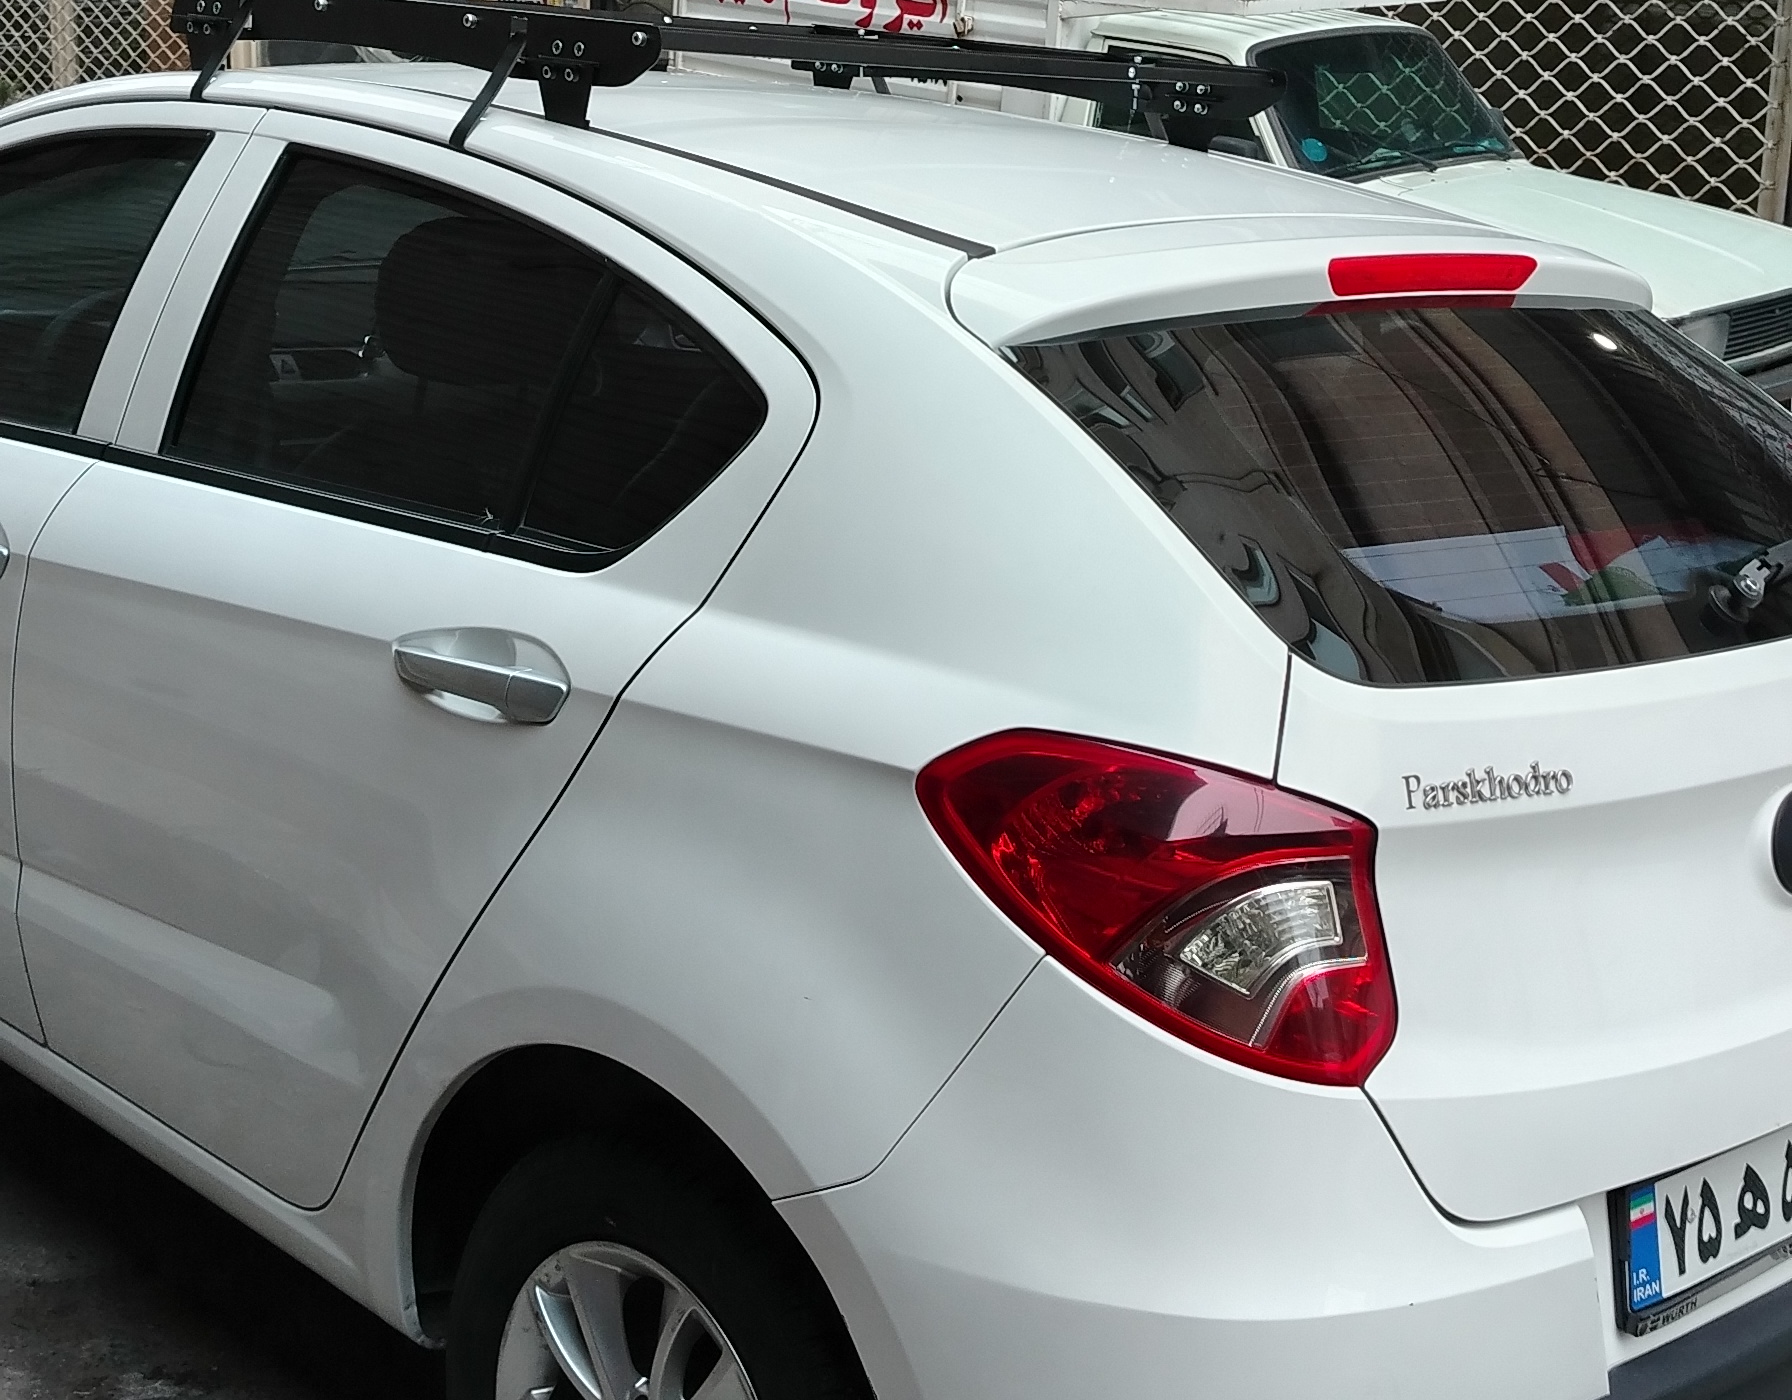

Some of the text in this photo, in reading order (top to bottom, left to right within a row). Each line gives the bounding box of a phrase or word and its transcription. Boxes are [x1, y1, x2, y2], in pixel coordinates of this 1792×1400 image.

[1401, 760, 1574, 811] Parskhodro
[1632, 1267, 1650, 1286] I.R.
[1633, 1280, 1660, 1303] IRAN
